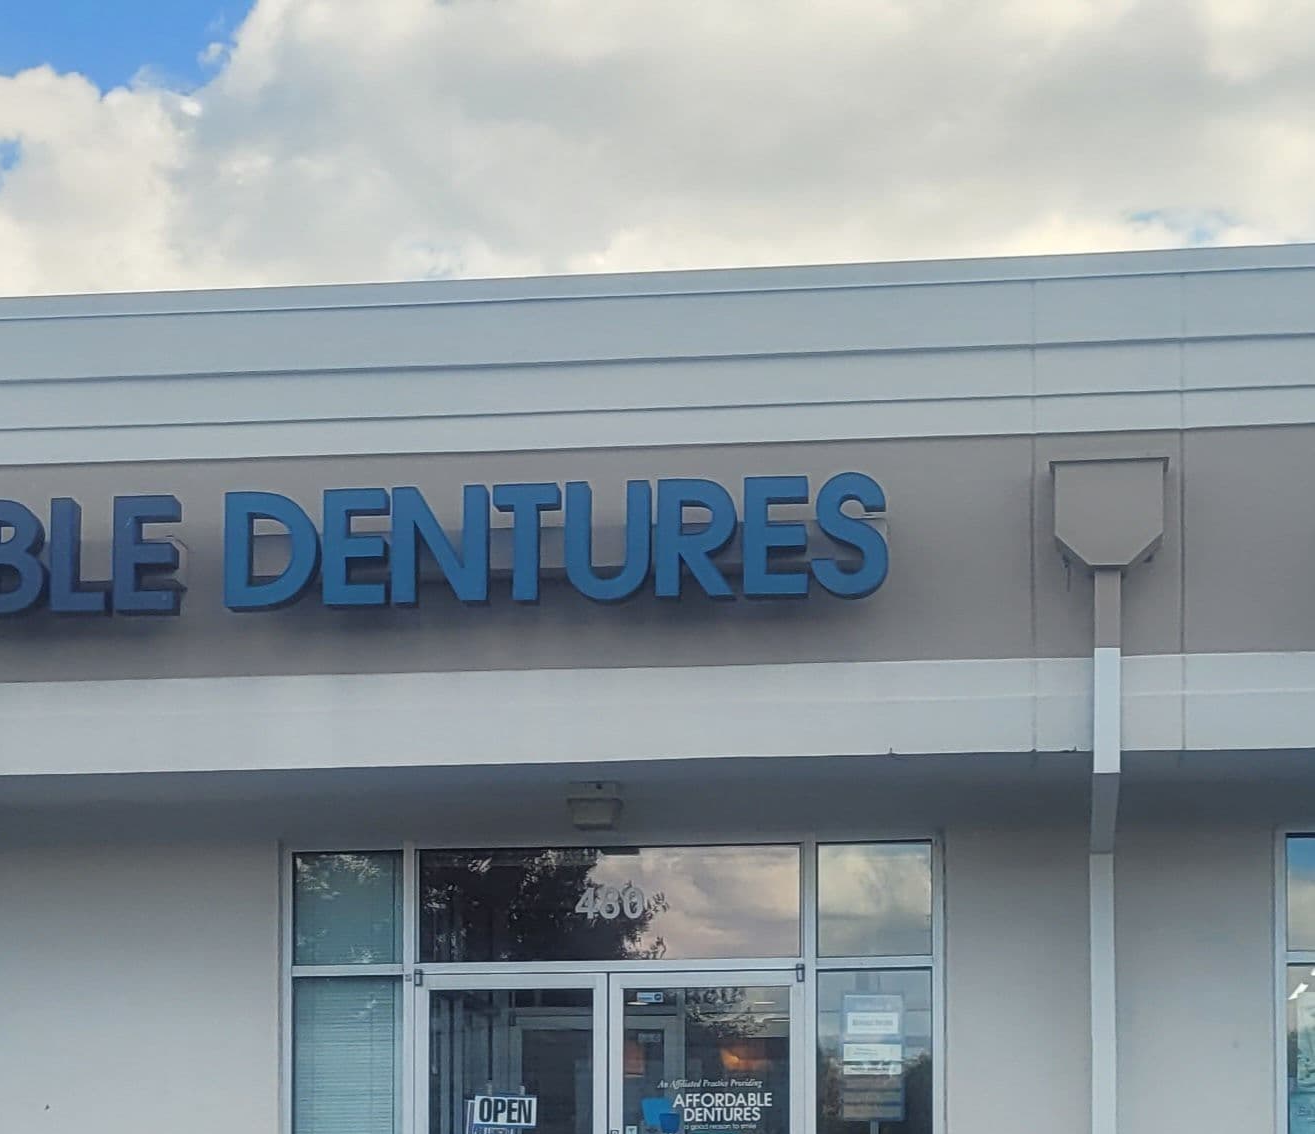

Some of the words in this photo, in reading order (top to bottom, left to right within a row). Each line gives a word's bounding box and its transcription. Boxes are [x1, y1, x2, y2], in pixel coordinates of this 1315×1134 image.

[224, 471, 890, 611] DENTURES
[575, 887, 644, 919] 480
[479, 1098, 532, 1124] OPEN
[672, 1092, 773, 1108] AFFORDABLE
[684, 1107, 761, 1122] DENTURES
